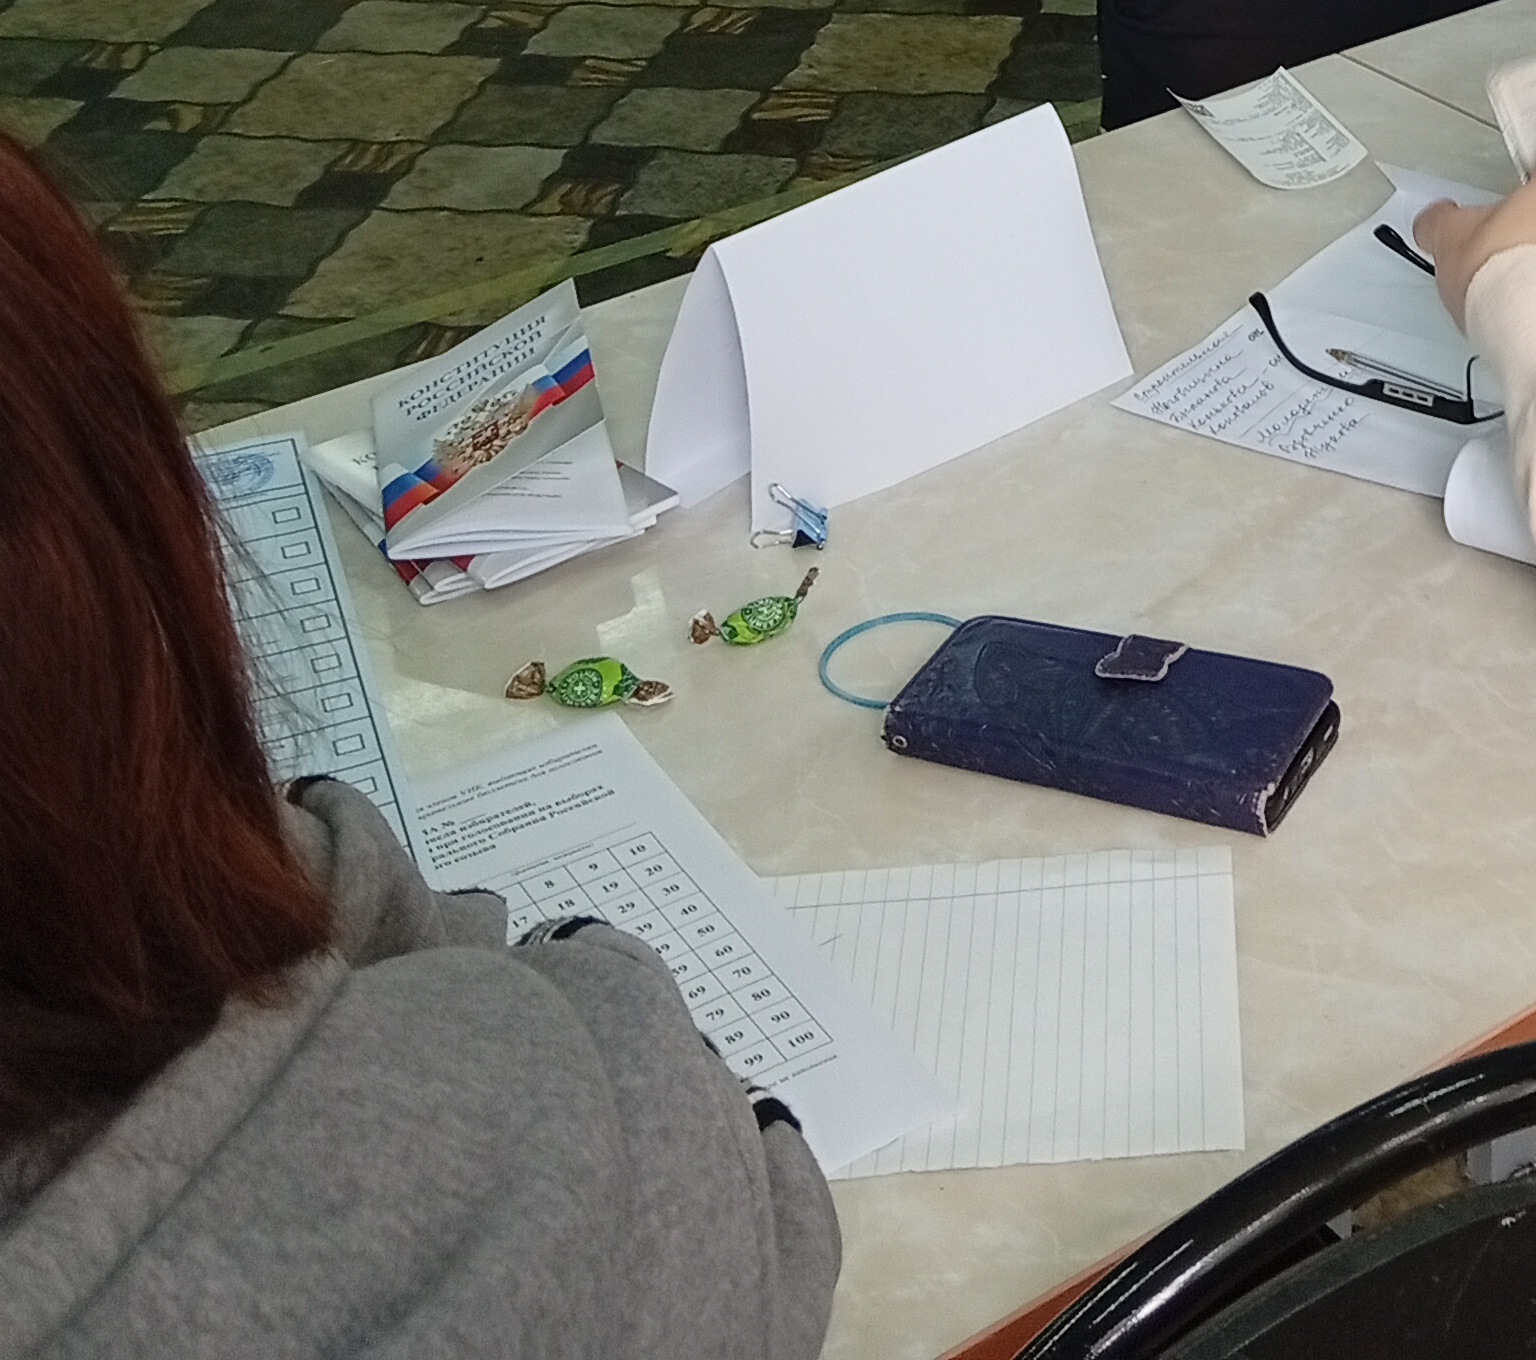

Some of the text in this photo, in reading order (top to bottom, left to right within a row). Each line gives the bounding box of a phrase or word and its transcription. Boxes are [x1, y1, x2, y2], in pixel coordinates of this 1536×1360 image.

[398, 314, 546, 409] КОНСТИТУЦИЯ
[405, 330, 542, 416] РОССИЙСКОЙ
[416, 347, 536, 421] ФЕДЕРАЦИИ
[588, 861, 599, 872] 9
[628, 842, 647, 857] 10
[511, 863, 664, 929] 17 18 19 20
[617, 882, 681, 915] 29 30
[679, 903, 698, 918] 40
[697, 923, 716, 938] 50
[714, 944, 734, 959] 60
[688, 965, 752, 1000] 69 70
[706, 988, 772, 1022] 79 80
[724, 1010, 791, 1046] 89 90
[743, 1029, 816, 1068] 99 100
